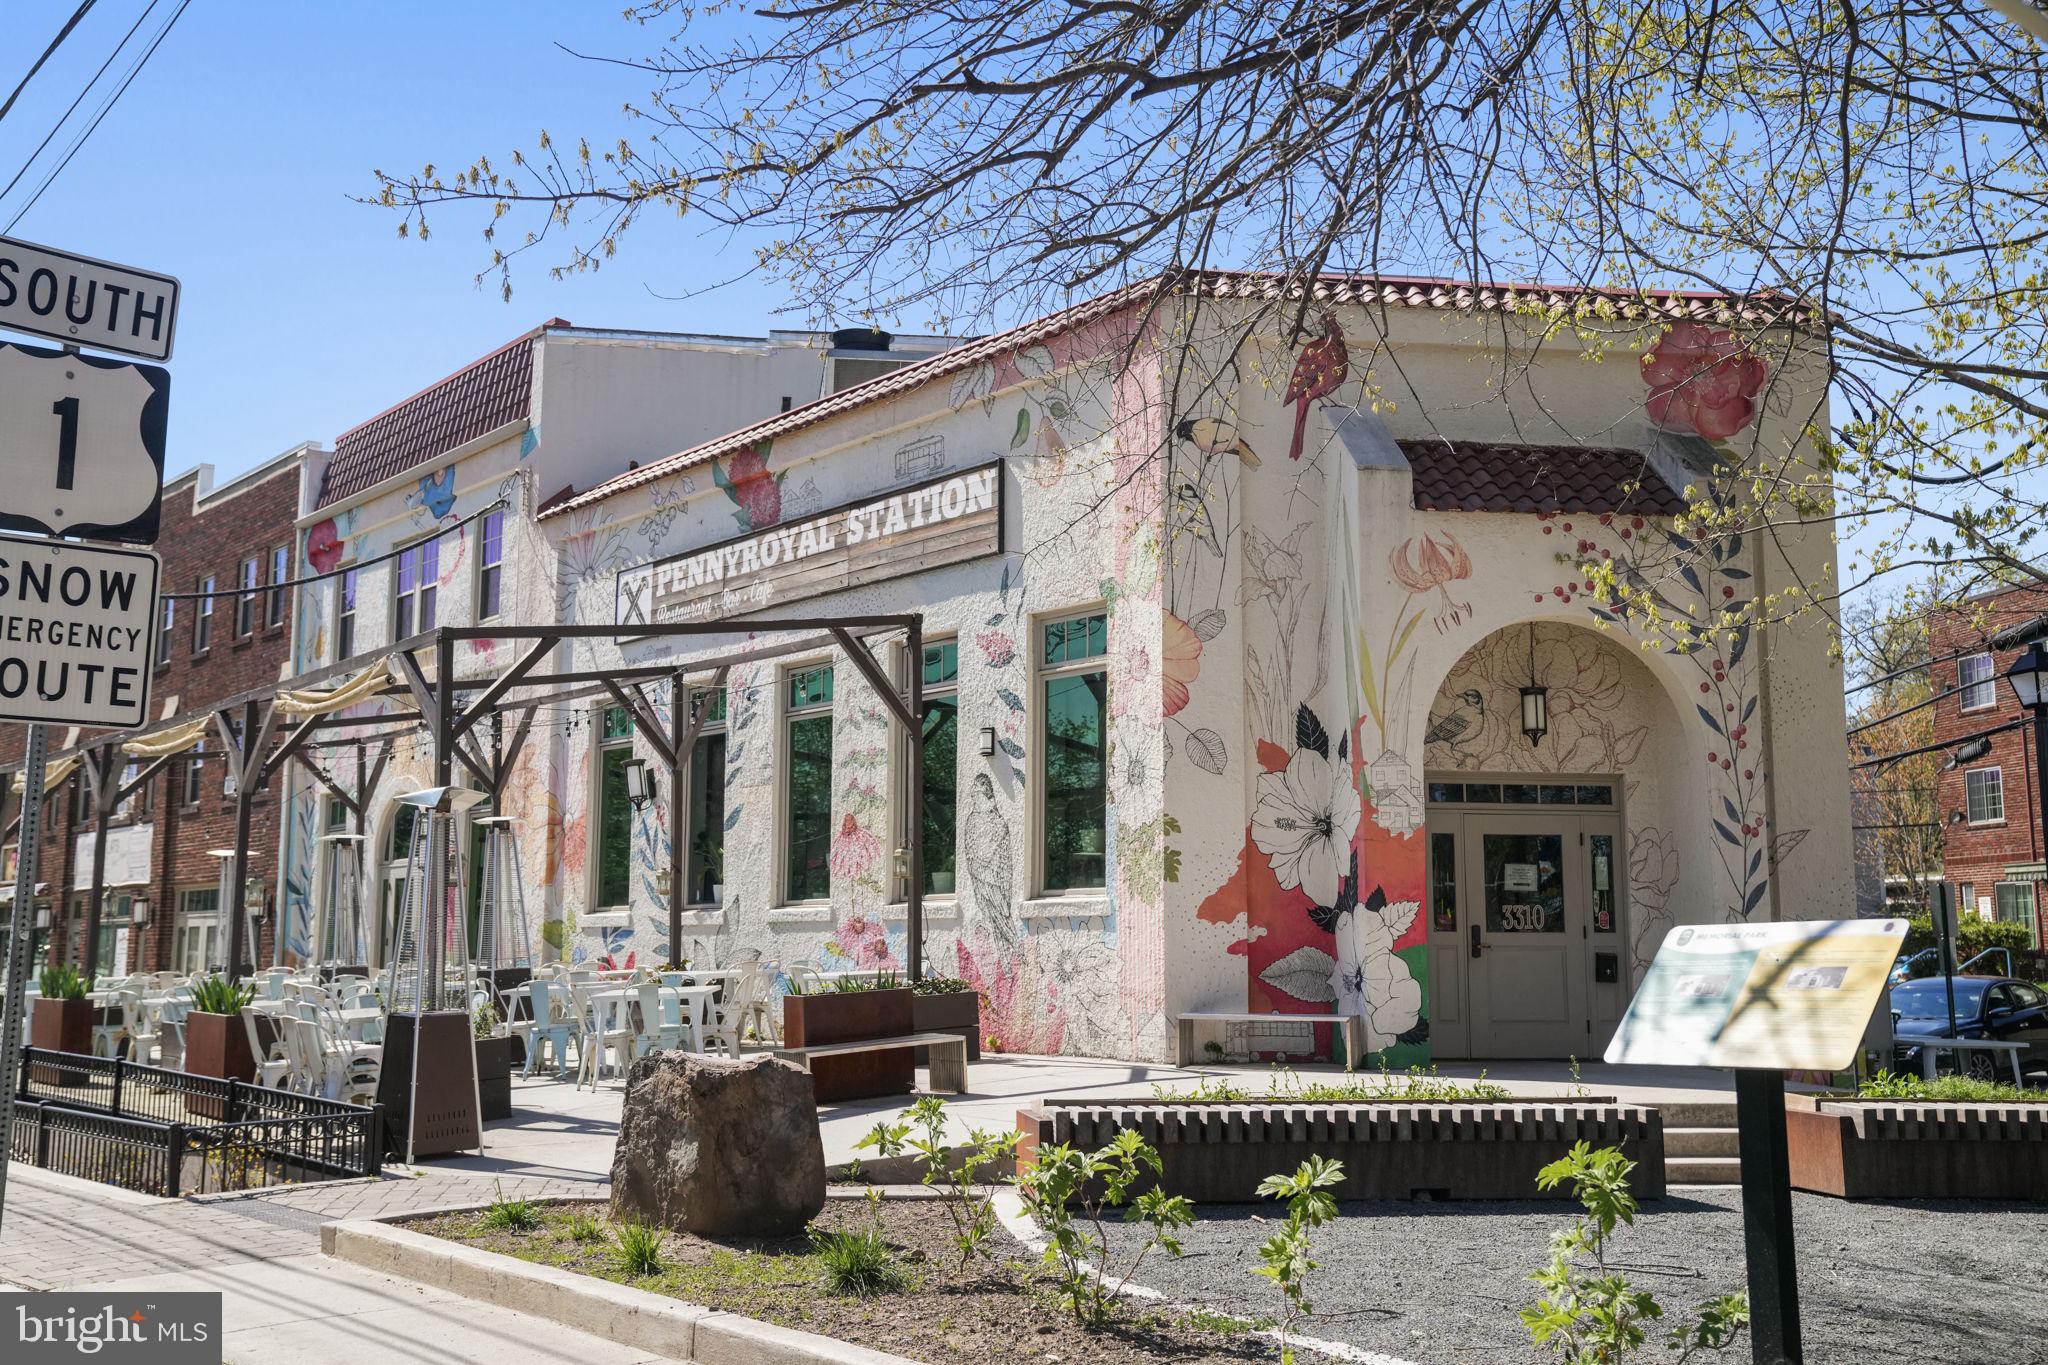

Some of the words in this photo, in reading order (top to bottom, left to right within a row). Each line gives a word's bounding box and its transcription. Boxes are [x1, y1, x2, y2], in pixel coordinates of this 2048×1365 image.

[0, 258, 165, 341] SOUTH
[52, 396, 80, 491] 1
[655, 518, 836, 598] PENNYROYAL
[846, 470, 996, 546] STATION
[655, 597, 713, 622] Restaurant
[721, 587, 741, 610] Bar
[0, 615, 142, 652] ERGENCY
[0, 657, 138, 708] OUTE
[1501, 904, 1545, 930] 3310
